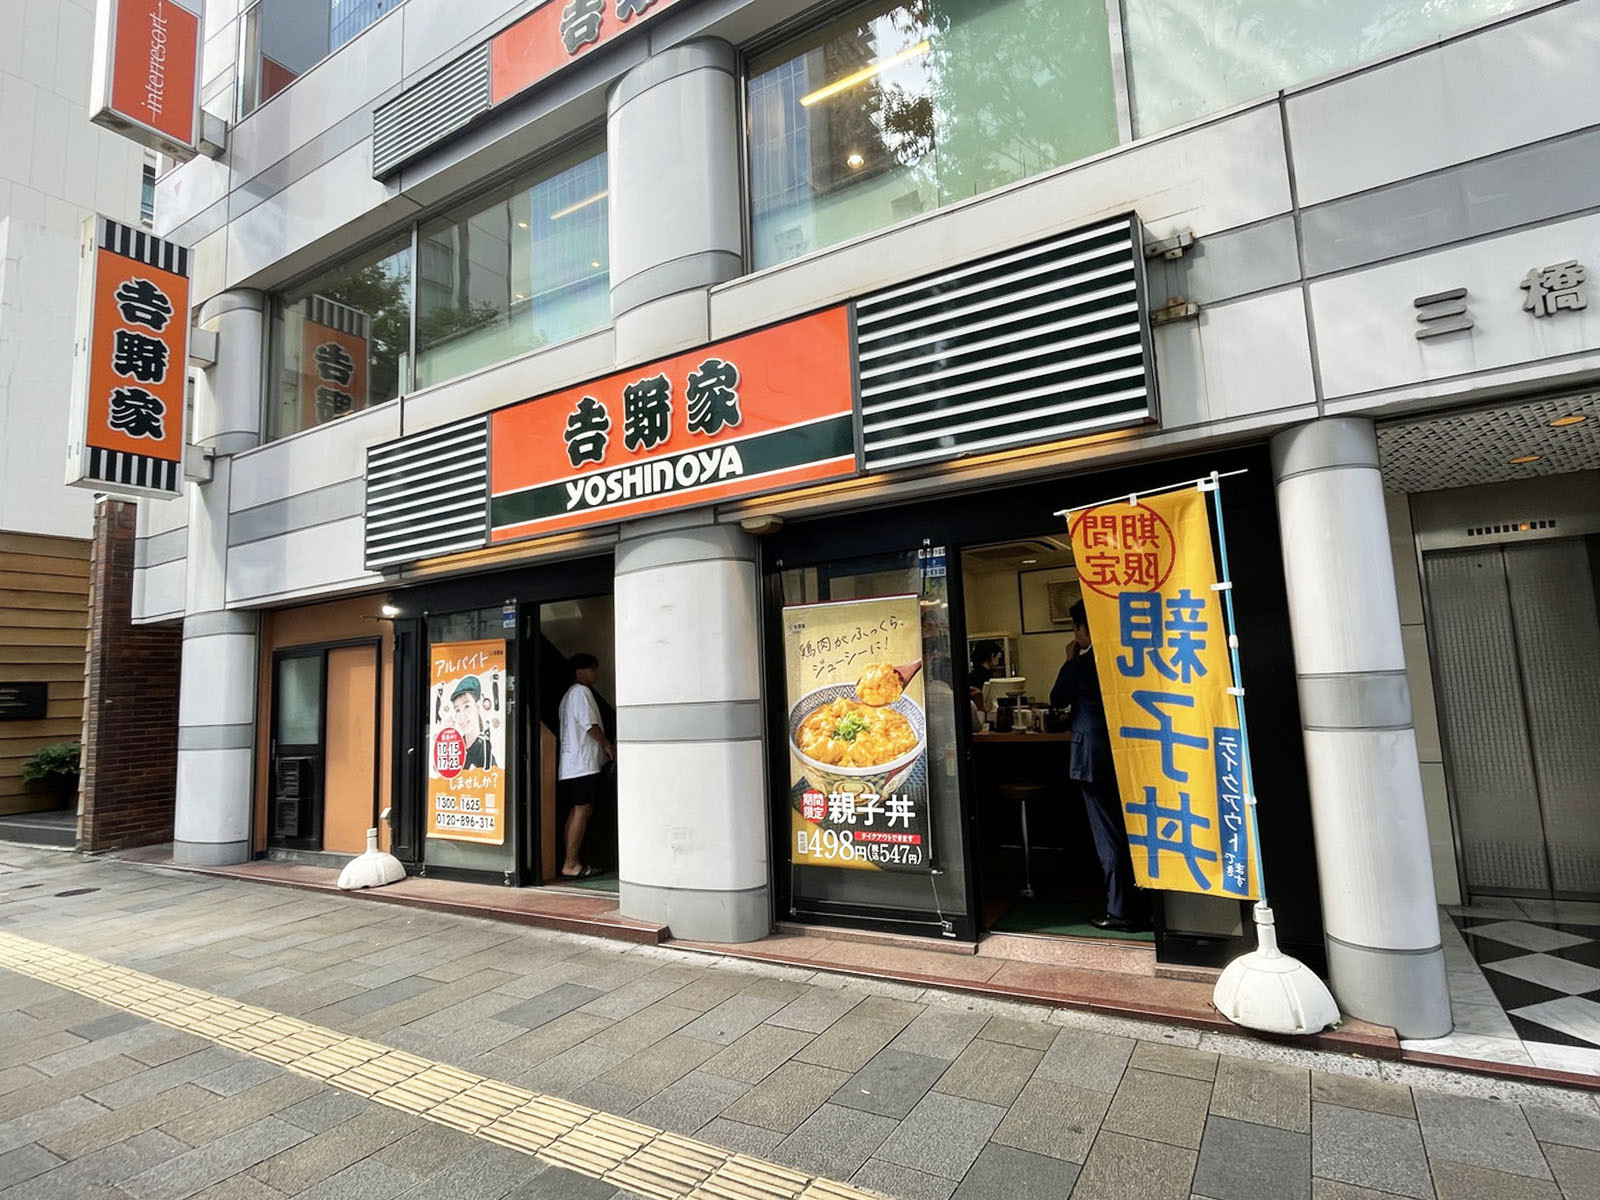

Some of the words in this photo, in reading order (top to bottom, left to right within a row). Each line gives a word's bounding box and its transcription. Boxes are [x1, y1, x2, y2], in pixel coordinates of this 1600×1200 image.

[141, 12, 168, 115] interresort
[435, 652, 489, 678] アルバイト
[828, 791, 916, 828] 親子丼
